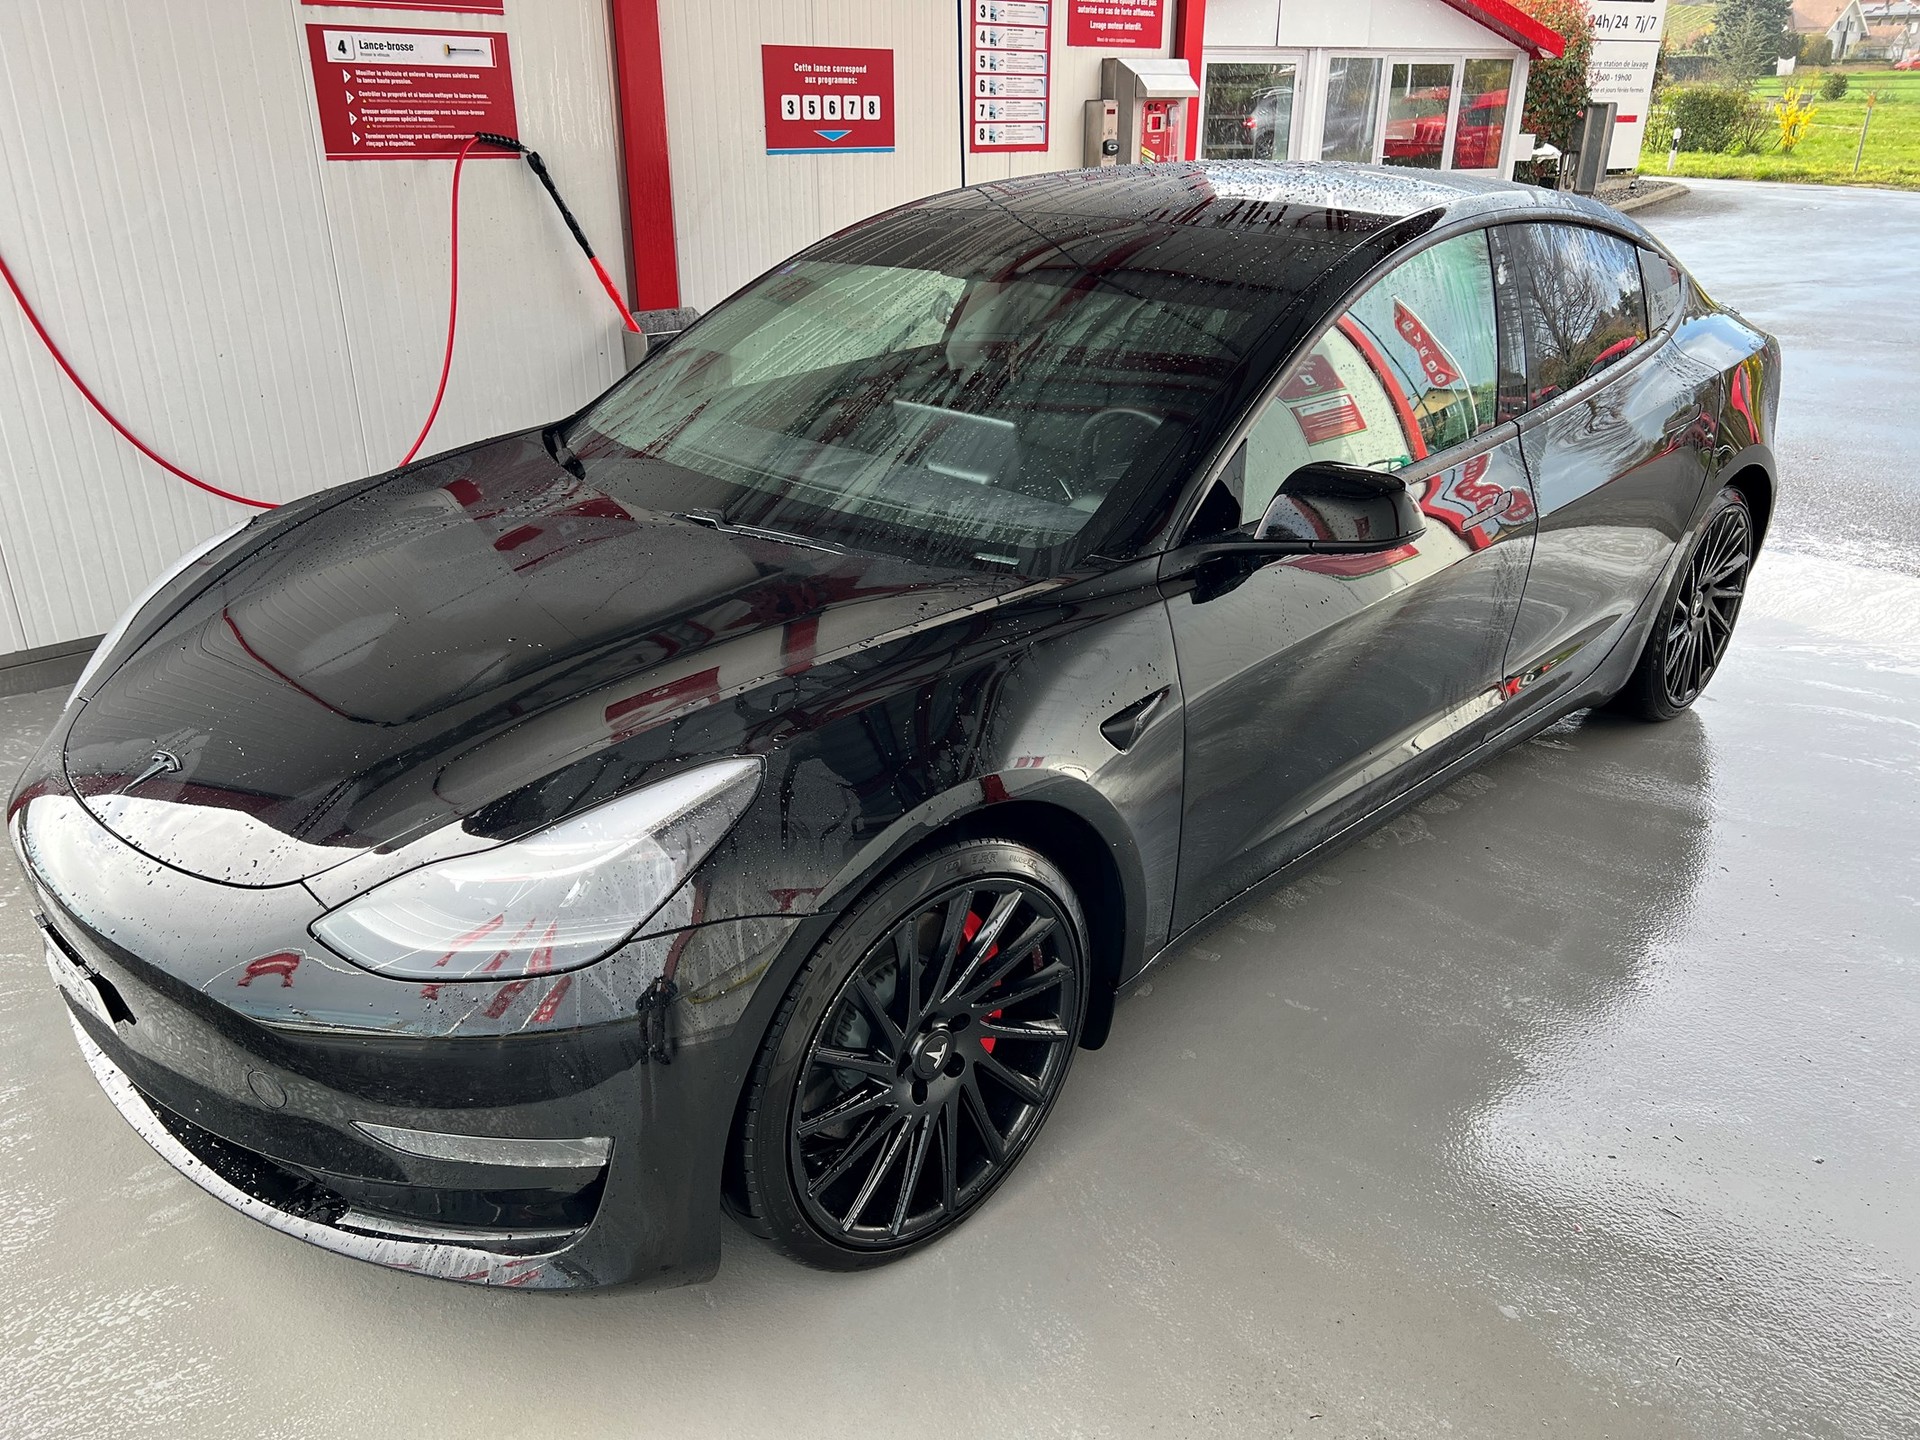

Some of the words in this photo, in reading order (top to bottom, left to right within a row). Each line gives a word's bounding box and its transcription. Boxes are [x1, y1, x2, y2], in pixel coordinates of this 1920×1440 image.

[980, 5, 985, 18] 3
[1635, 15, 1657, 33] 7j/7
[980, 30, 985, 43] 4
[338, 40, 346, 54] 4
[359, 40, 414, 51] Lance-brosse
[980, 56, 985, 68] 5
[794, 63, 811, 72] Cette
[813, 64, 831, 73] lance
[833, 65, 867, 74] correspond
[818, 77, 857, 86] programmes:
[980, 80, 985, 92] 6
[787, 100, 794, 115] 3
[809, 100, 815, 115] 5
[829, 101, 836, 115] 6
[849, 101, 855, 115] 7
[869, 101, 875, 115] 8
[980, 104, 985, 116] 7
[980, 128, 985, 140] 8
